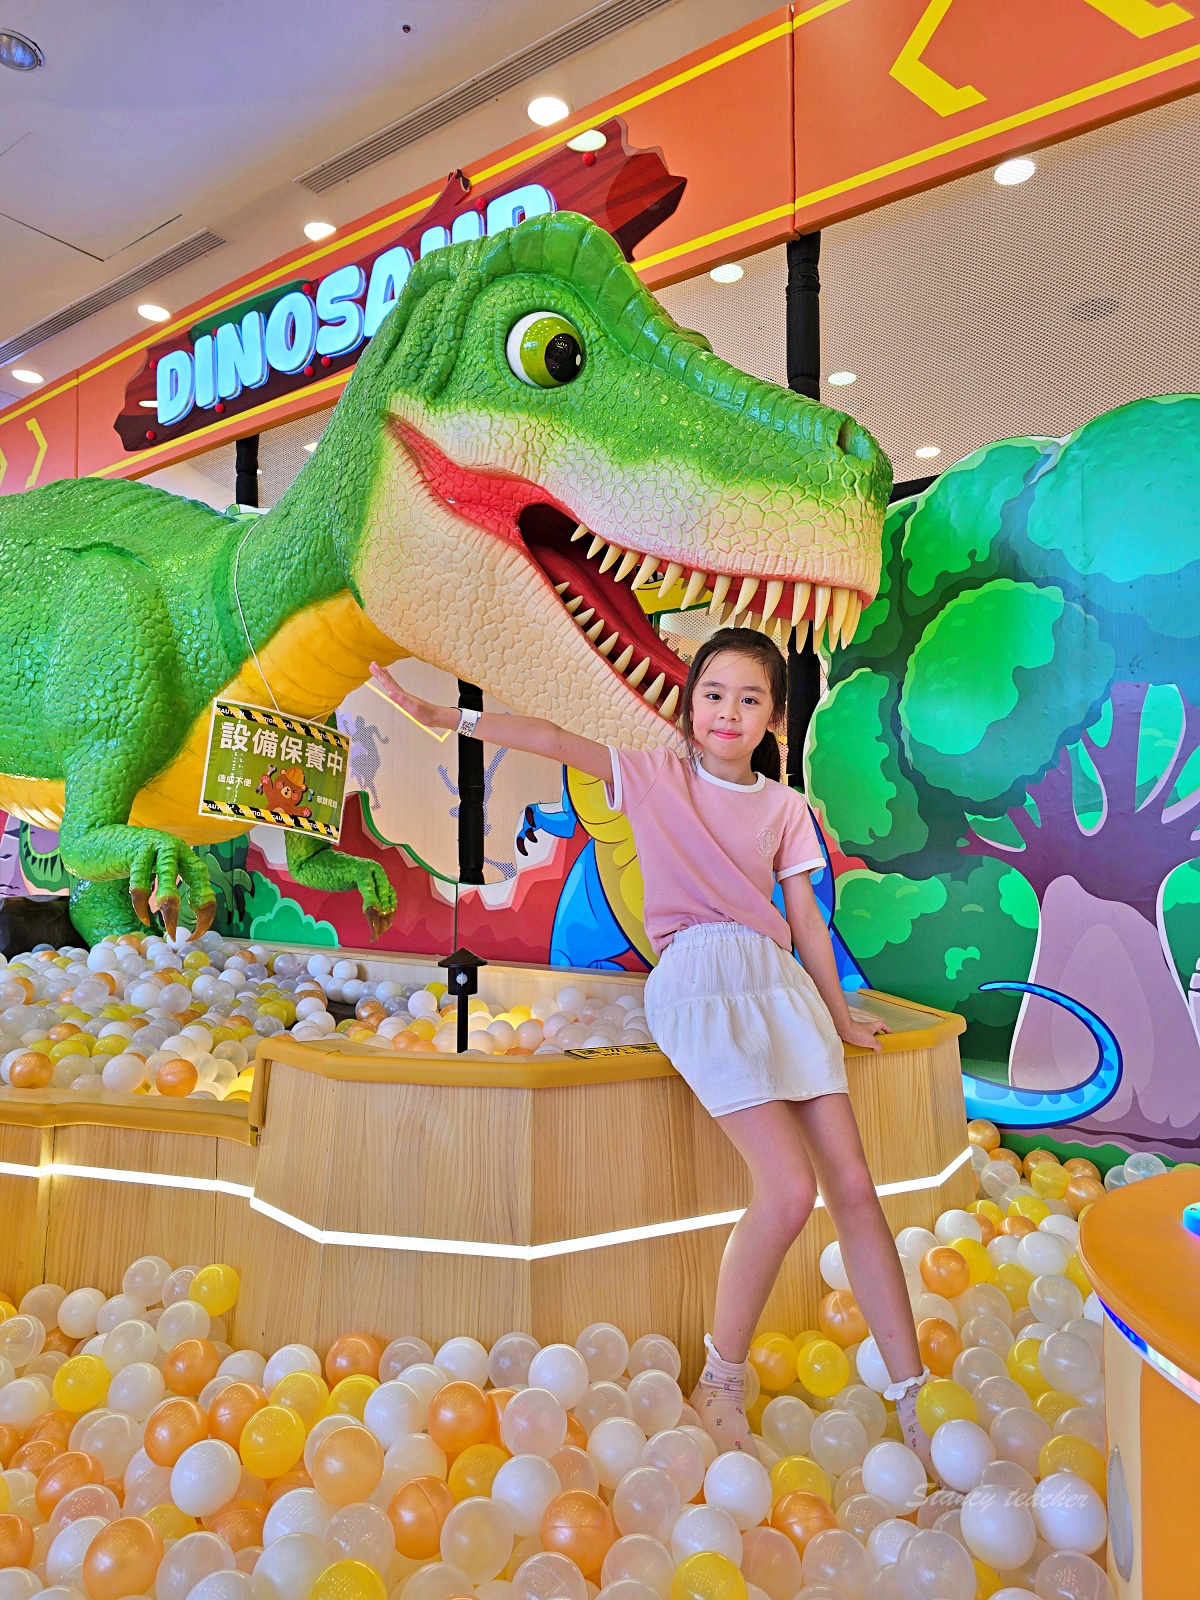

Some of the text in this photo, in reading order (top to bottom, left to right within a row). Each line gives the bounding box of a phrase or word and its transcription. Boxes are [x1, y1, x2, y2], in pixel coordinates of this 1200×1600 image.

[220, 721, 343, 776] 設備保養中
[217, 773, 252, 787] 造成不便
